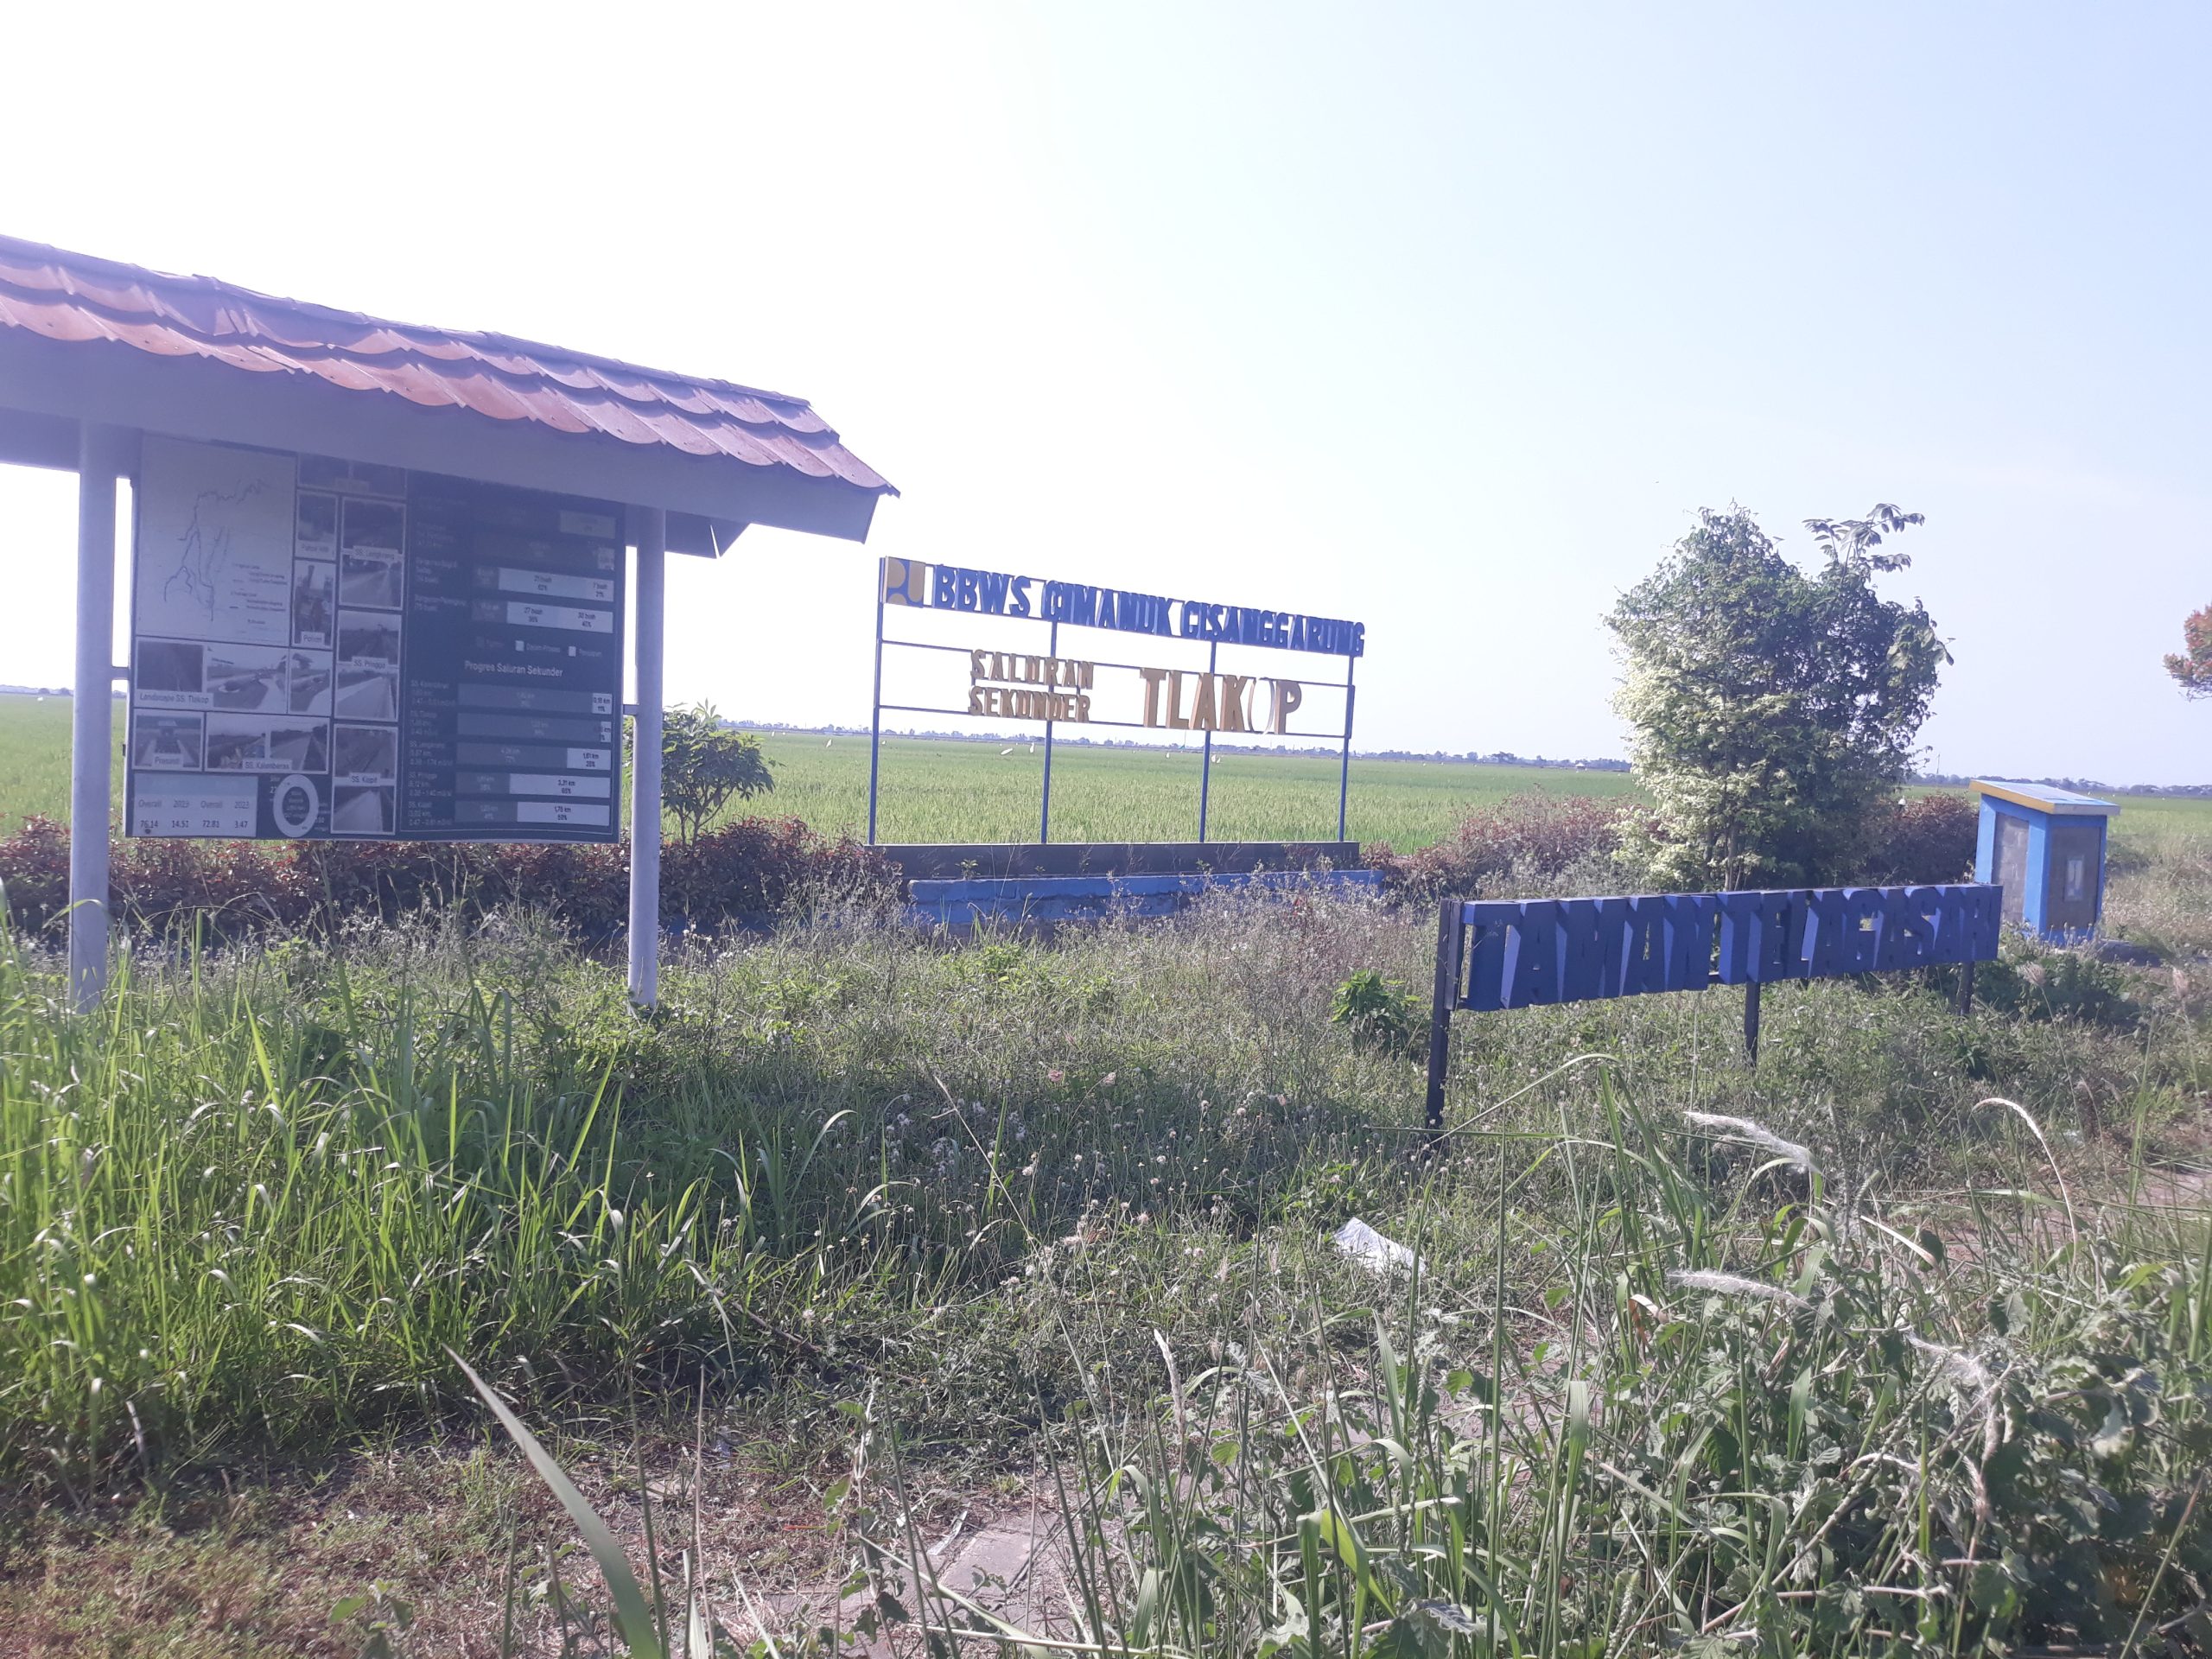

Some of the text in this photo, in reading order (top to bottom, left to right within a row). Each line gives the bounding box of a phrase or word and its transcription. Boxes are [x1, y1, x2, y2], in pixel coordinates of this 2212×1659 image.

[932, 564, 1366, 657] BBWS CIMANUK CISANGGARUNG
[464, 660, 563, 677] Progres Saluran Sekunder
[970, 650, 1094, 690] SALURAN
[968, 685, 1090, 723] SEKUNDER
[1140, 667, 1302, 734] TLAKOP
[1462, 894, 1716, 1013] TAMAN
